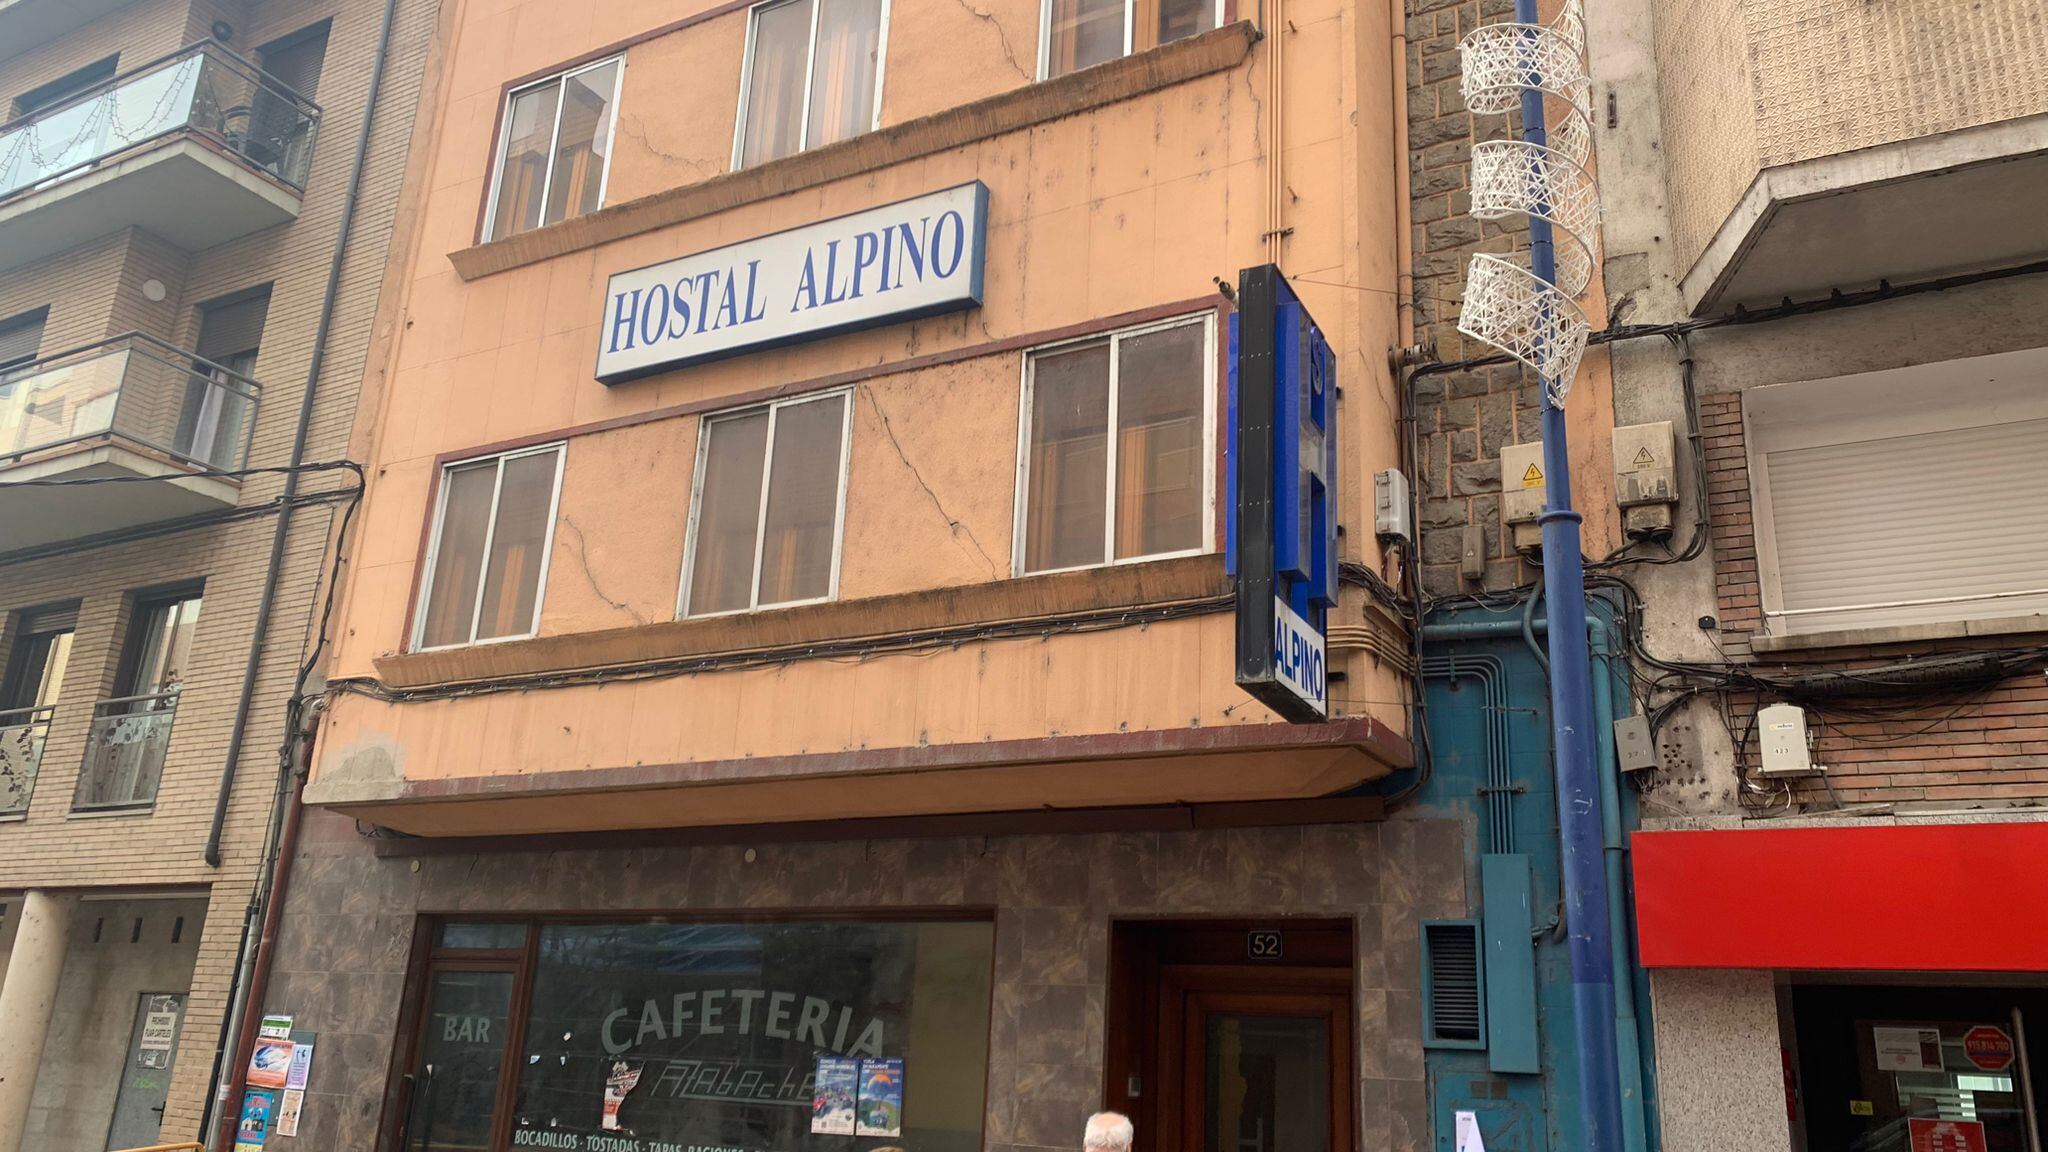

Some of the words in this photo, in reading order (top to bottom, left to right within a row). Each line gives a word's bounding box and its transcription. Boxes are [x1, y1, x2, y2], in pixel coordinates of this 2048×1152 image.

[607, 260, 767, 354] HOSTAL
[790, 210, 965, 313] ALPINO
[1275, 616, 1323, 702] ALPINO
[1253, 935, 1278, 954] 52
[443, 1016, 490, 1043] BAR
[601, 989, 885, 1057] CAFETERIA
[514, 1129, 578, 1150] BOCADILLOS
[586, 1135, 639, 1152] TOSTADAS
